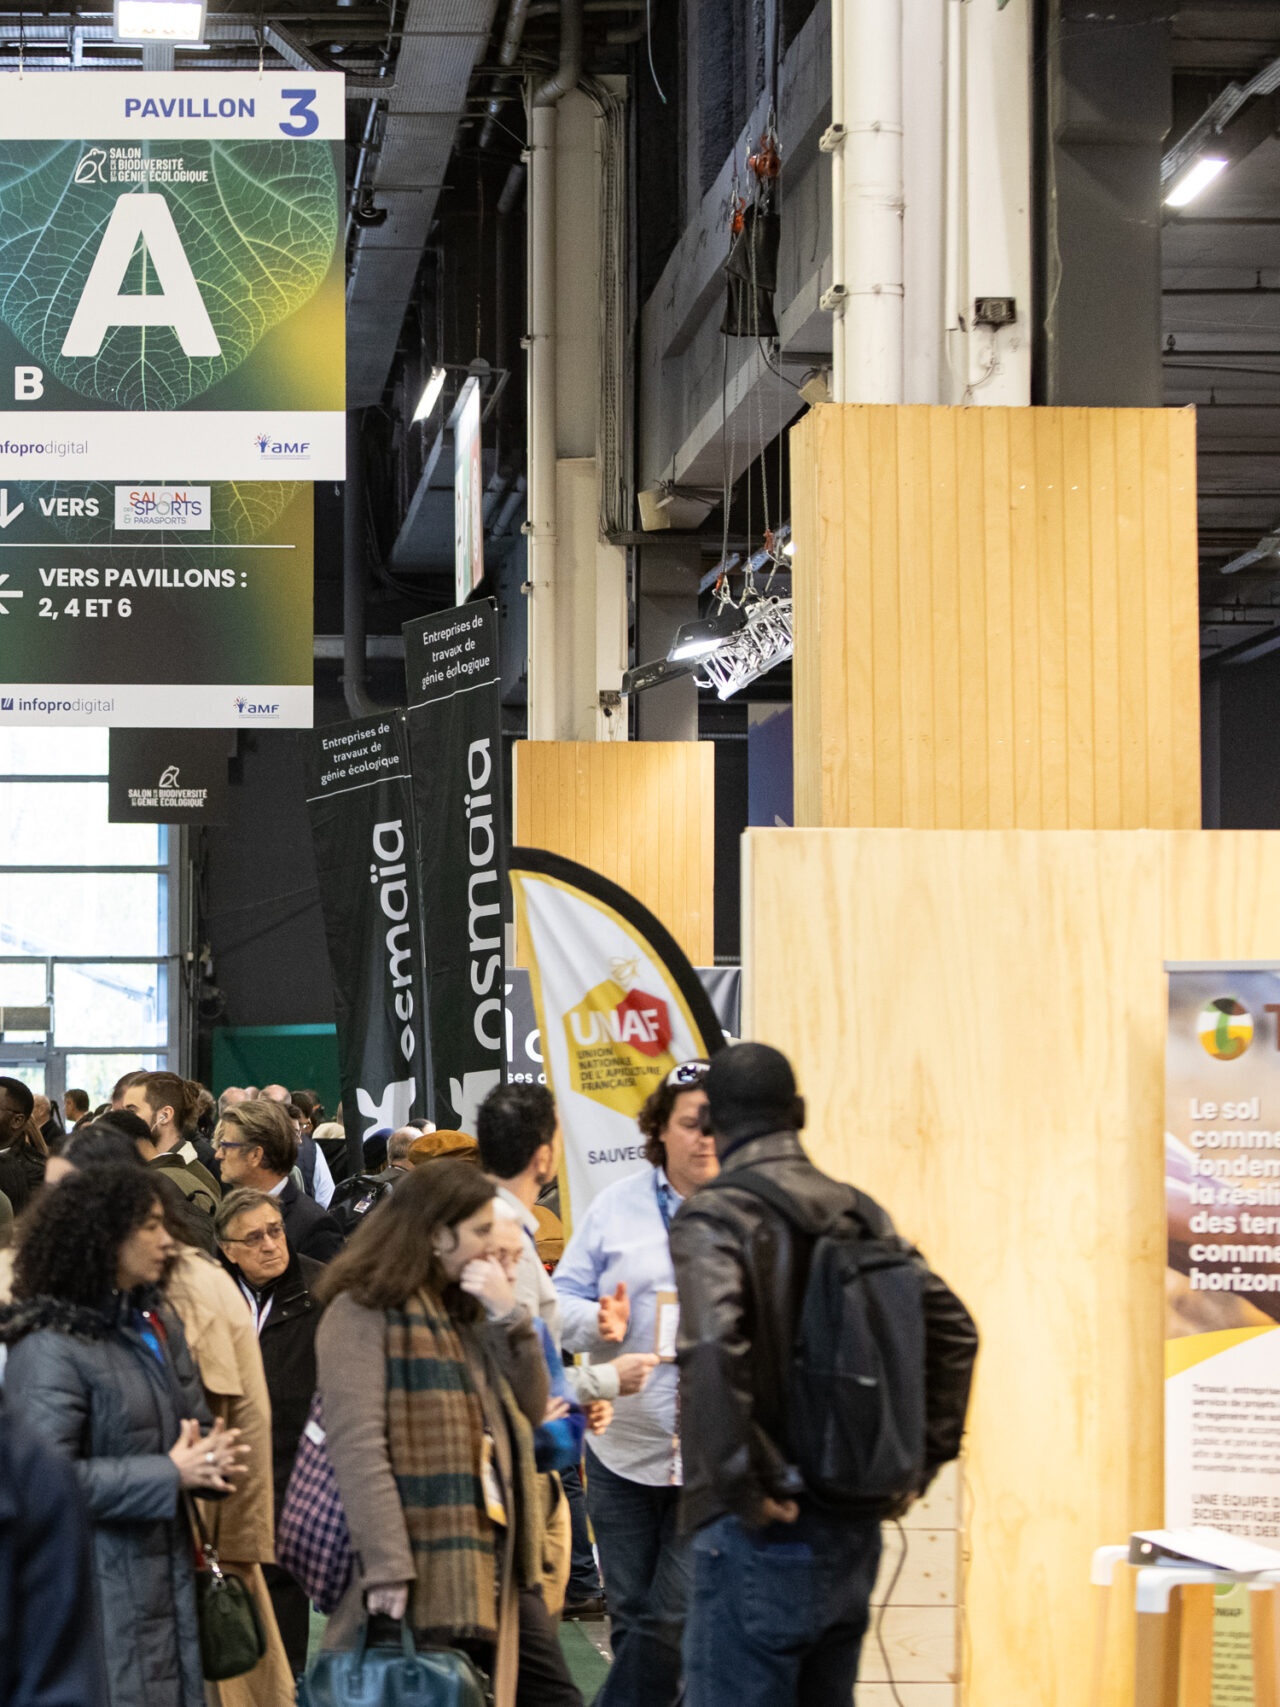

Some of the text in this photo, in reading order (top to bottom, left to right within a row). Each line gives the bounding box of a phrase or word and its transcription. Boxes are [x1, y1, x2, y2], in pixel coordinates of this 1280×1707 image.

[125, 89, 320, 137] PAVILLON 3
[109, 147, 142, 159] SALON
[118, 157, 184, 170] BIODIVERSITÉ
[118, 170, 148, 182] GÉNIE
[149, 170, 208, 183] ÉCOLOGIQUE
[61, 193, 222, 357] A
[14, 366, 44, 400] B
[38, 497, 100, 517] VERS
[129, 491, 187, 507] SALON
[134, 500, 202, 516] SPORTS
[133, 516, 187, 525] PARASPORTS
[38, 568, 100, 588] VERS
[105, 568, 236, 588] PAVILLONS
[38, 598, 132, 620] 2, 4 ET 6
[423, 615, 483, 645] Entreprises de
[432, 638, 476, 662] travaux de
[421, 670, 444, 691] génie
[18, 697, 115, 715] infoprodigital
[322, 723, 390, 750] Entreprises de
[333, 742, 382, 763] travaux de
[321, 755, 400, 785] génie écologique
[128, 789, 152, 798] SALON
[158, 788, 208, 798] BIODIVERSITÉ
[137, 798, 159, 807] GÉNIE
[160, 798, 204, 807] ÉCOLOGIQUE
[570, 1008, 660, 1046] UNAF
[576, 1047, 613, 1059] UNION
[1190, 1096, 1260, 1121] Le sol
[1189, 1210, 1237, 1234] des
